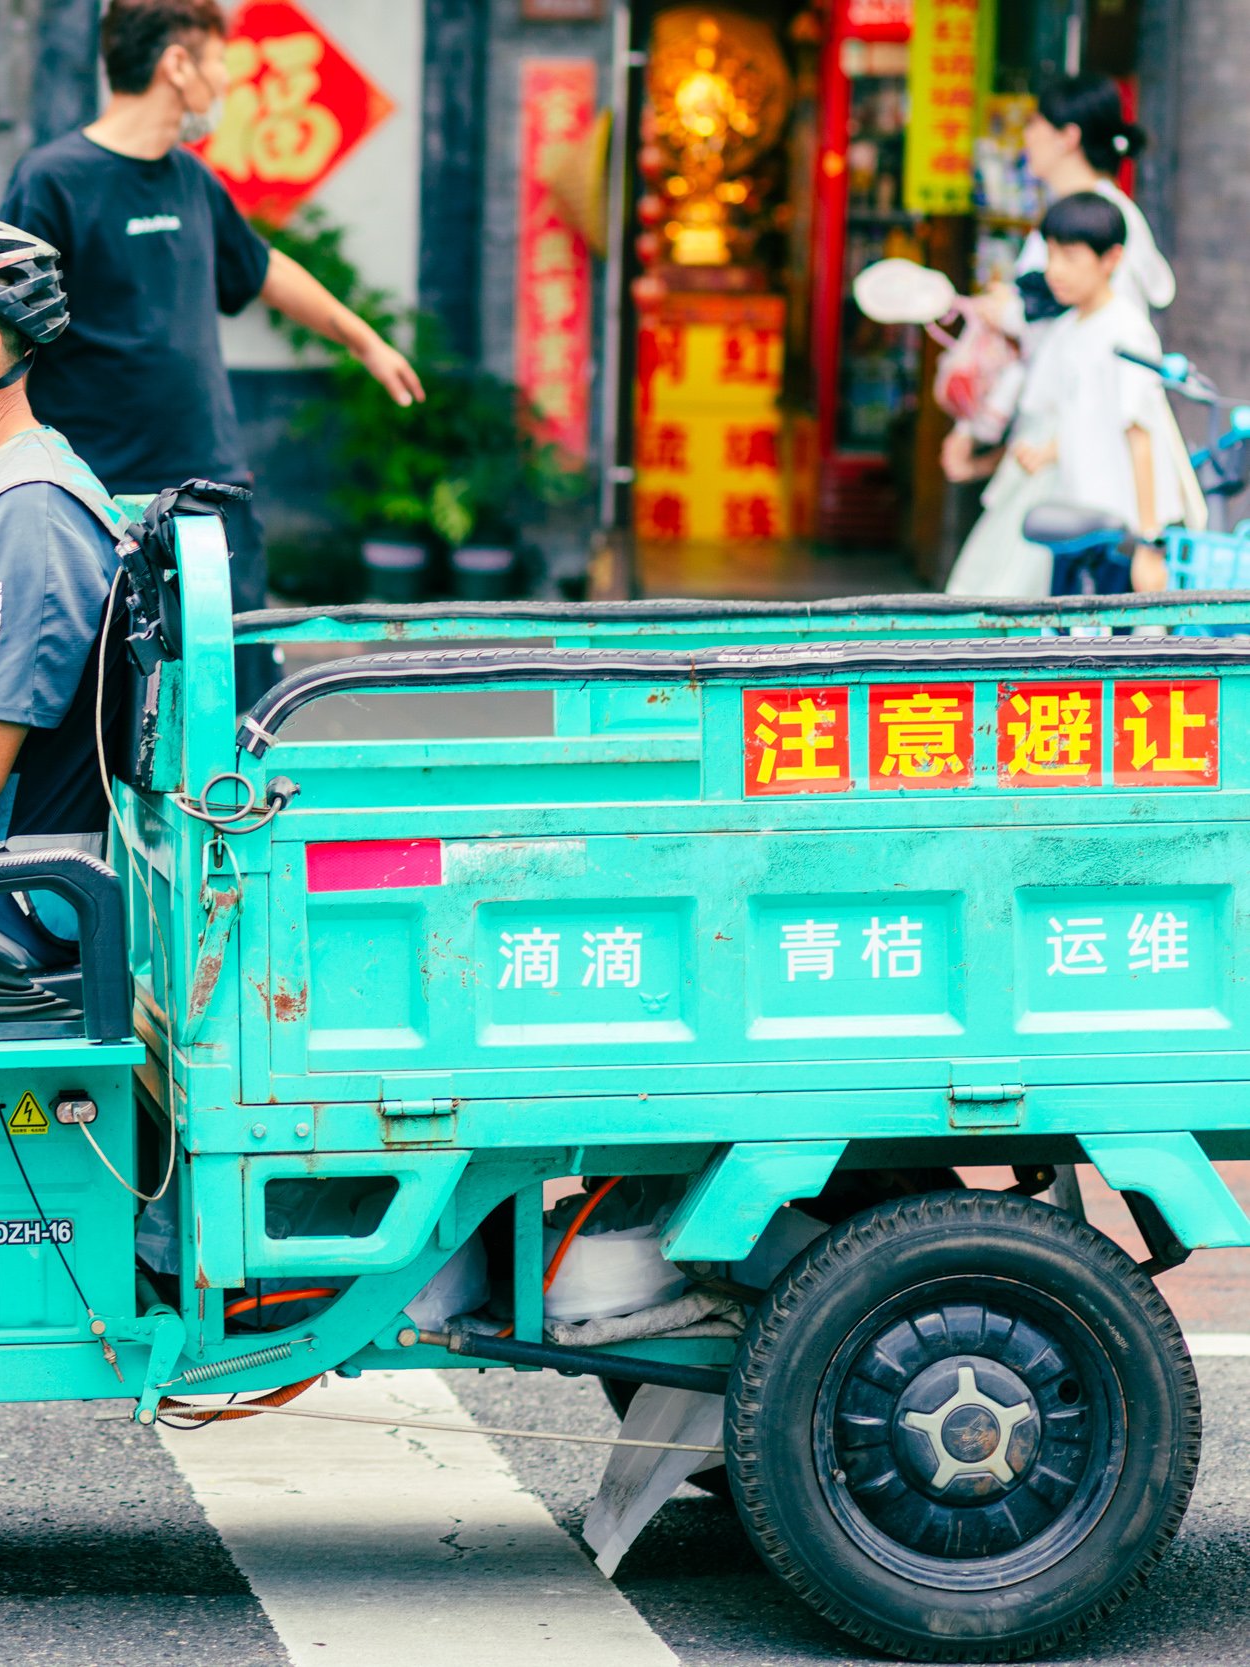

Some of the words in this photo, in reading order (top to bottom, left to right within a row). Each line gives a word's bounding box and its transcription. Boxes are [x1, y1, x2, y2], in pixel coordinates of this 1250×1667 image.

[206, 32, 342, 182] 福
[753, 690, 1207, 785] 注意避让
[497, 926, 643, 990] 滴滴
[779, 915, 924, 982] 青桔
[1045, 911, 1190, 977] 运维
